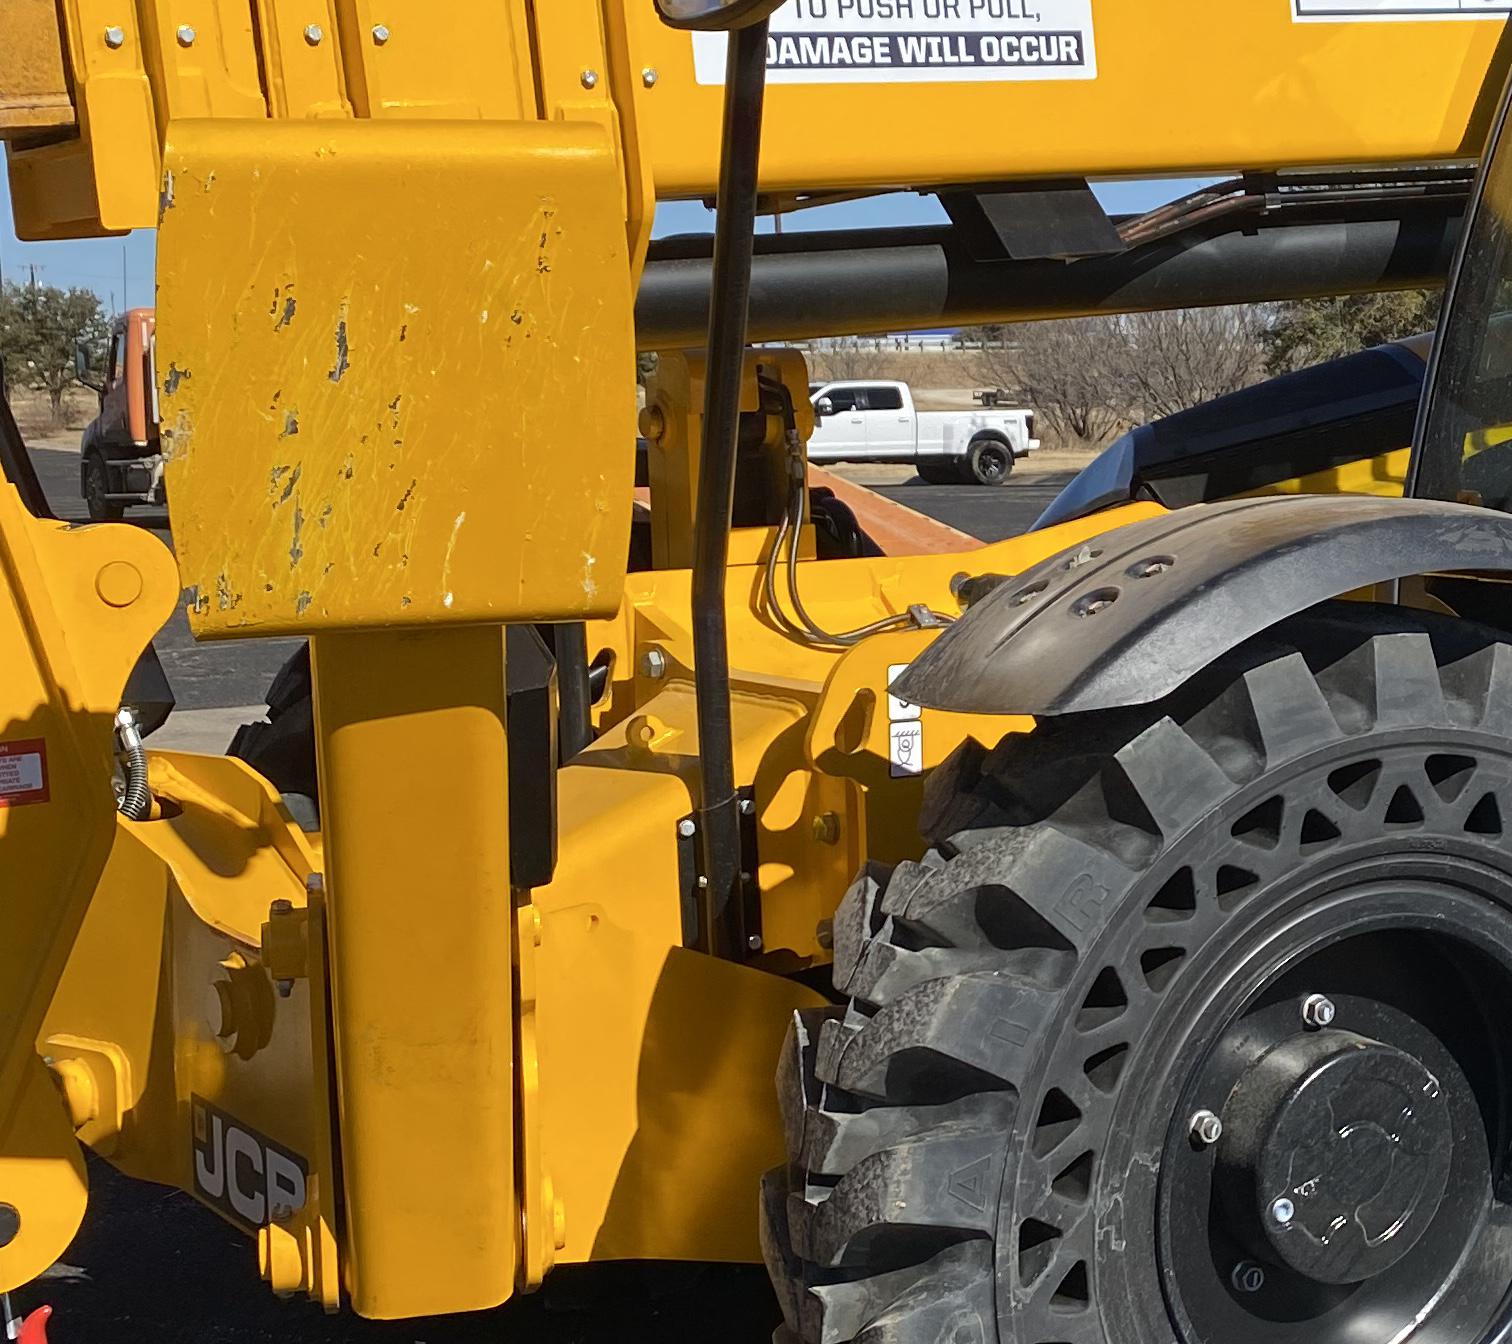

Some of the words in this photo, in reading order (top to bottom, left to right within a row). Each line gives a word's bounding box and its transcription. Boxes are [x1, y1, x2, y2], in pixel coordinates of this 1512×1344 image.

[897, 36, 975, 64] WILL
[979, 35, 1080, 63] OCCUR
[195, 1115, 306, 1224] JCB
